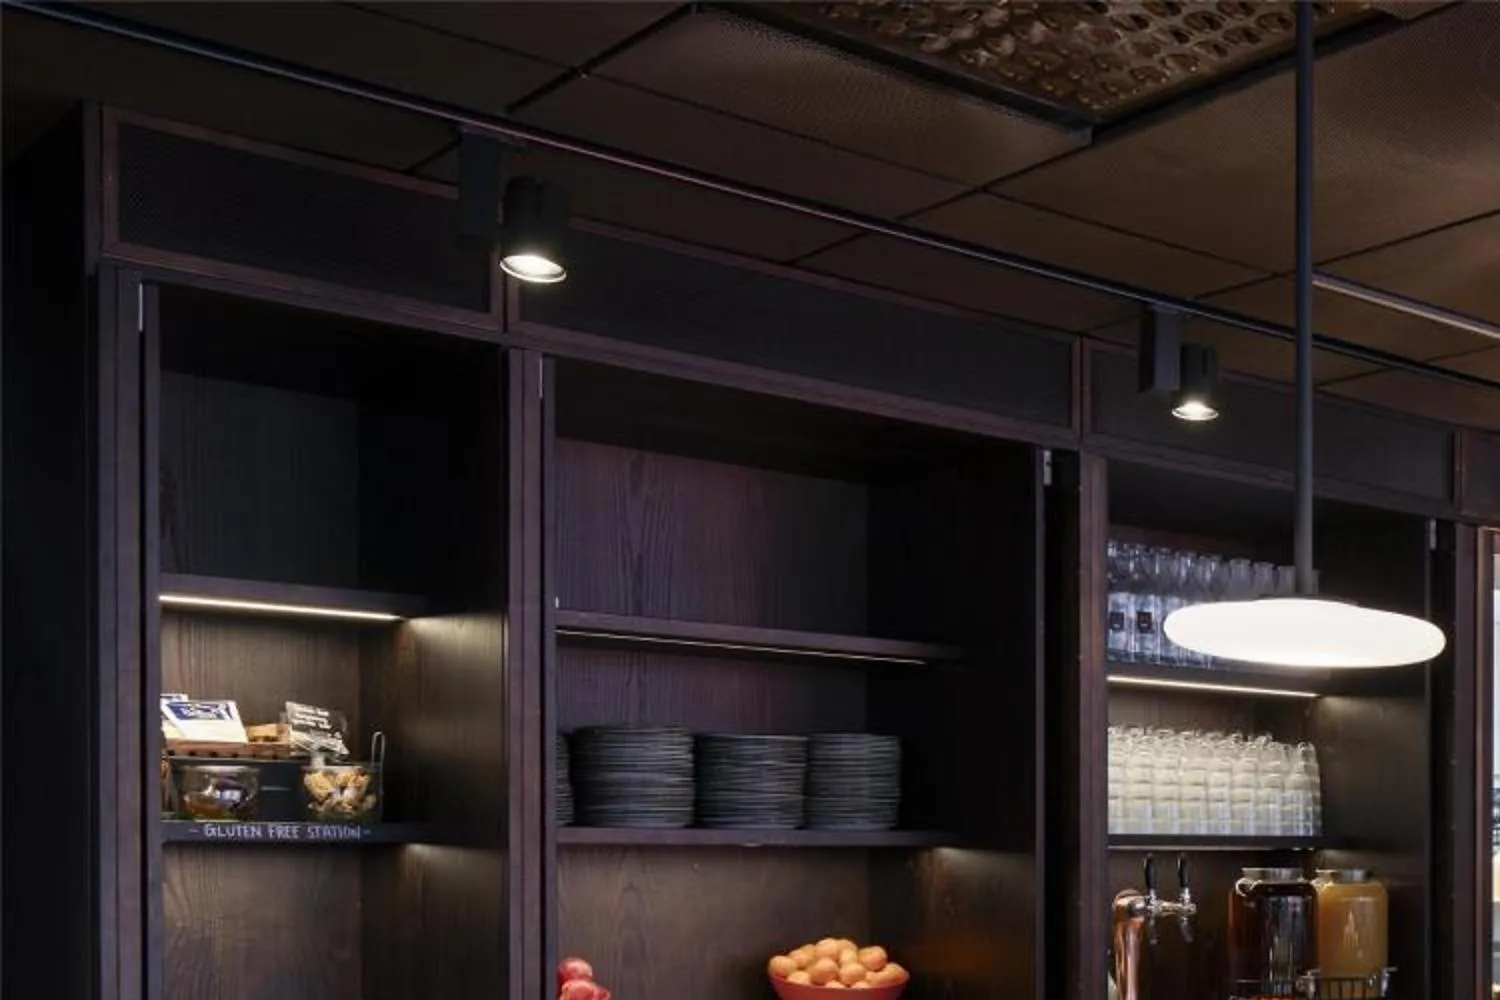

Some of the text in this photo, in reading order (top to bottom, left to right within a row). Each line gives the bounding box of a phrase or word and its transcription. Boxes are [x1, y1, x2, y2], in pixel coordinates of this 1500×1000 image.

[204, 823, 361, 840] GLUTEN FREE STATION
